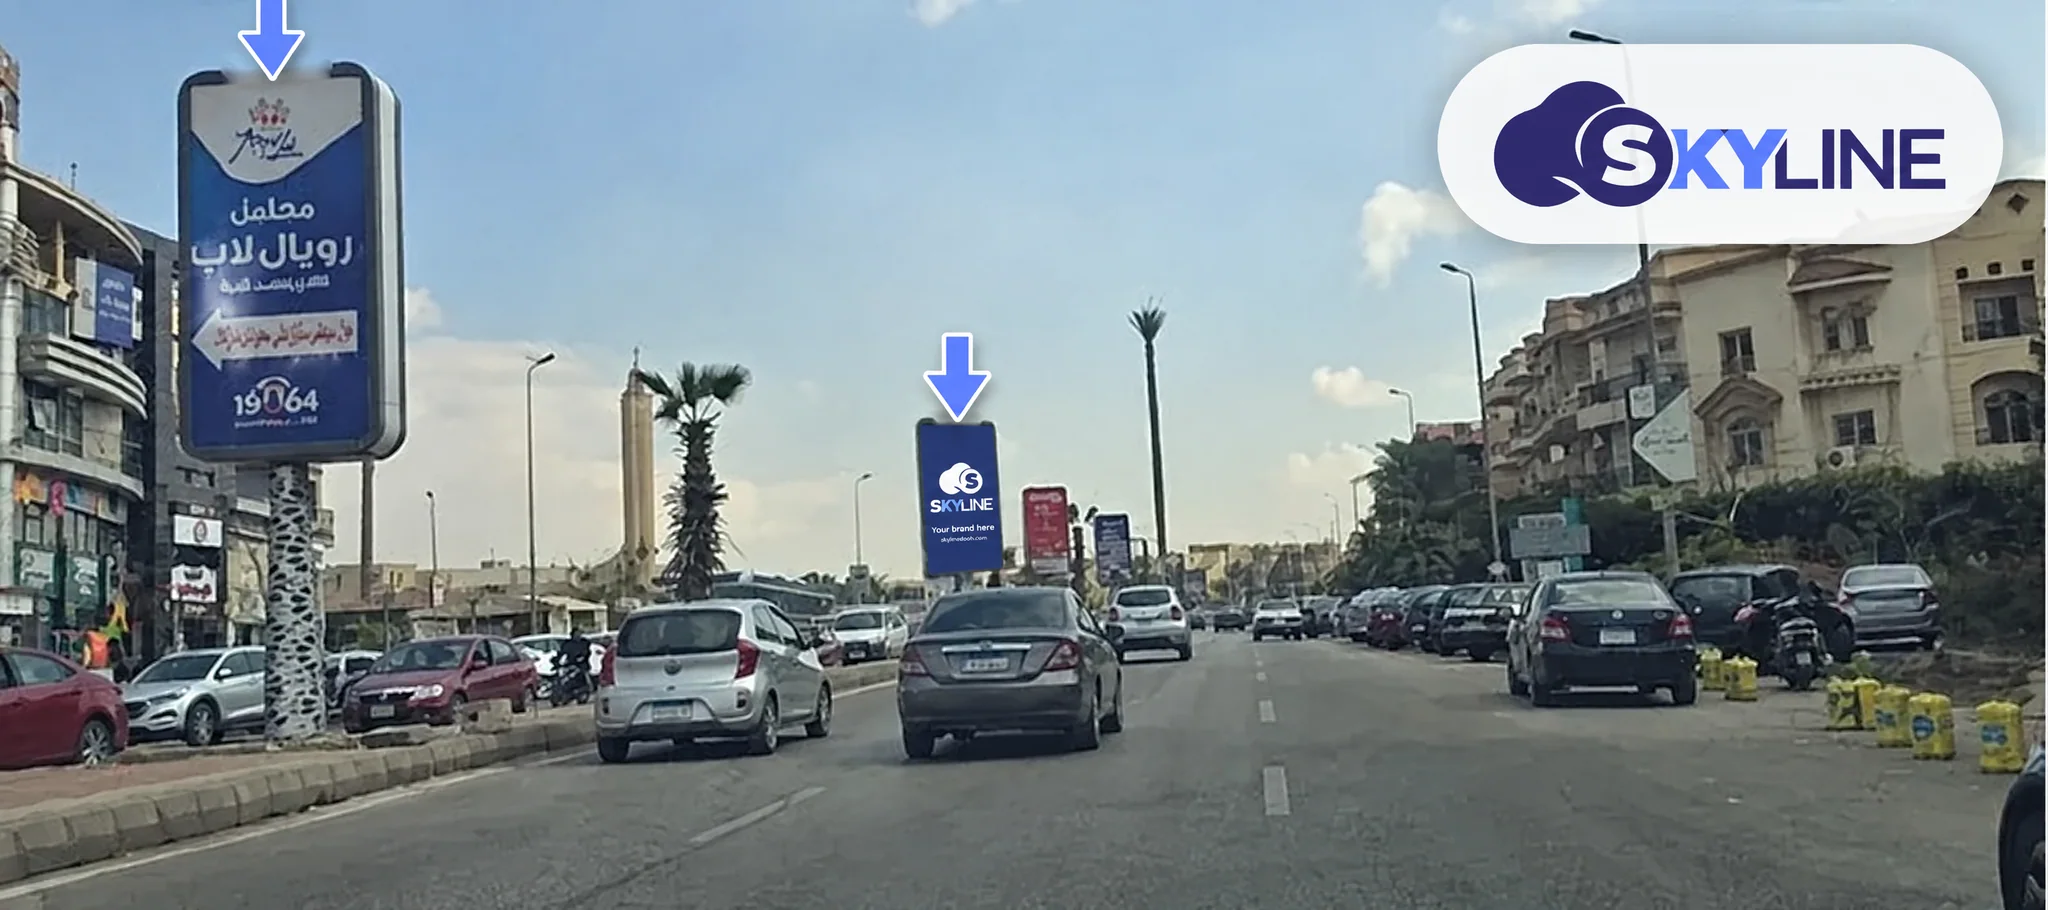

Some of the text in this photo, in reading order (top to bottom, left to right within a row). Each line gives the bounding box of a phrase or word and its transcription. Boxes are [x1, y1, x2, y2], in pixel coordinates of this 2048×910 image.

[259, 232, 353, 269] رويال
[930, 498, 993, 513] SKYLINE
[931, 524, 995, 534] Your brand here
